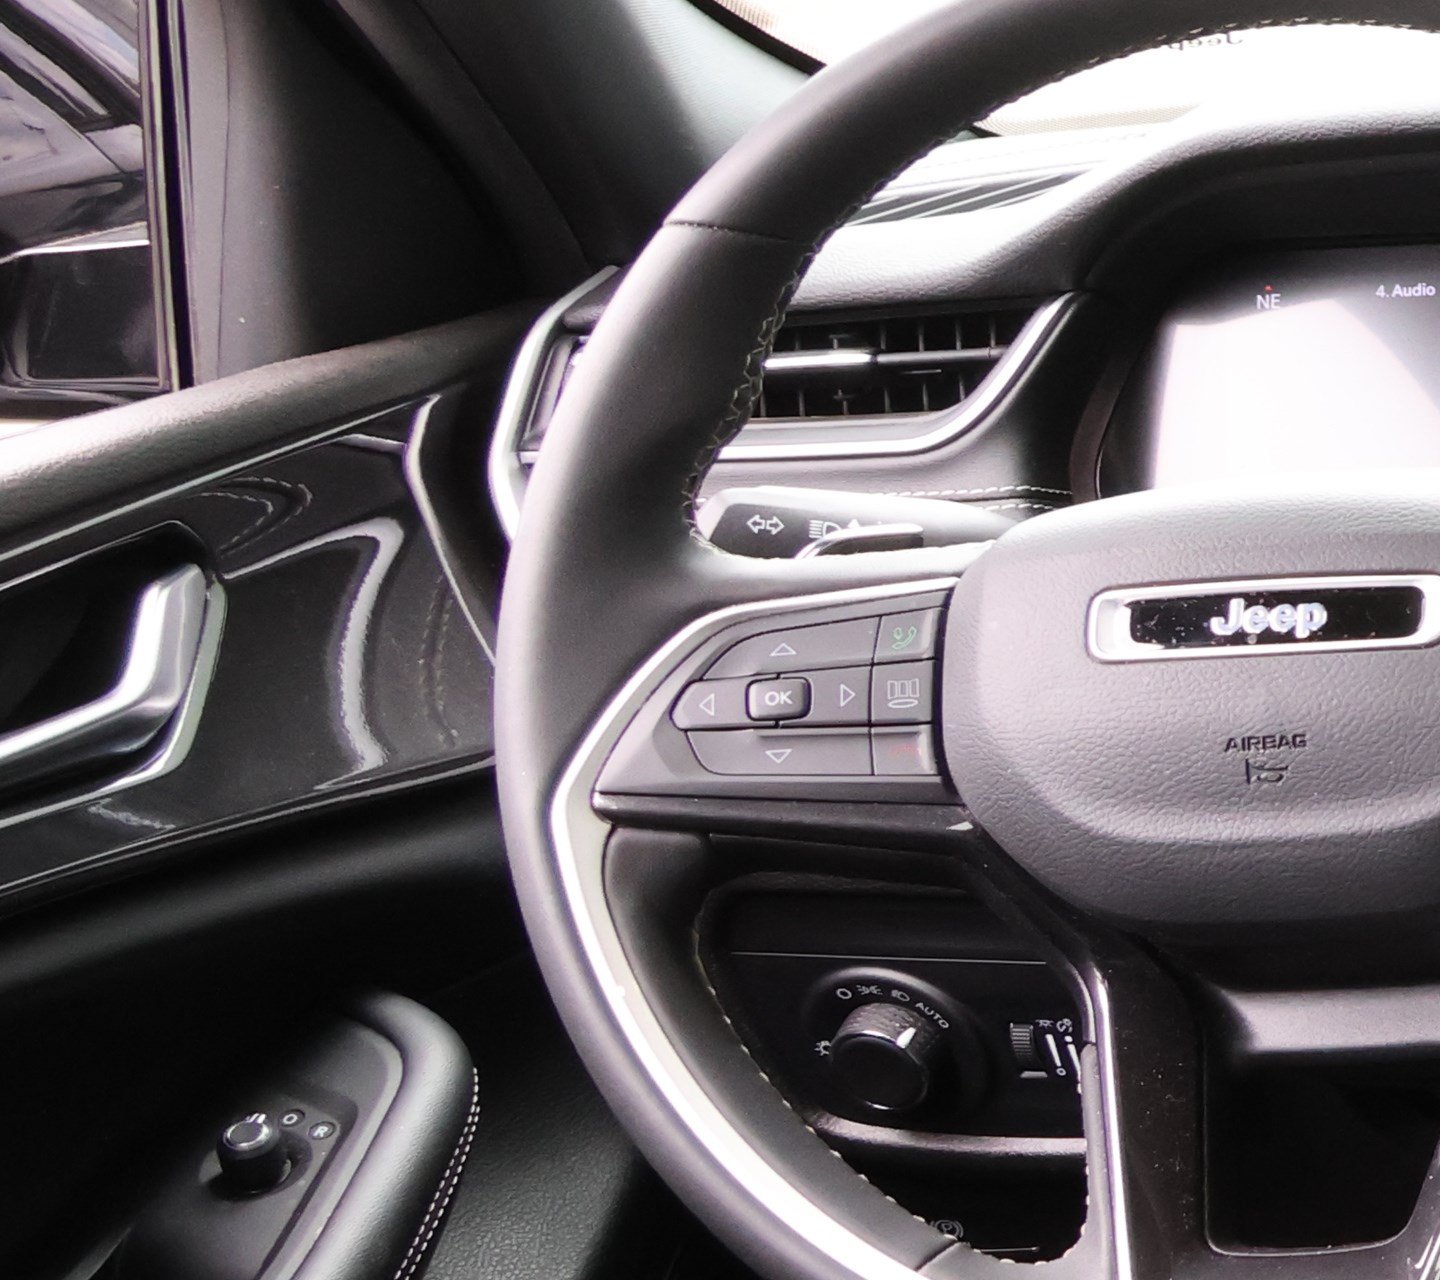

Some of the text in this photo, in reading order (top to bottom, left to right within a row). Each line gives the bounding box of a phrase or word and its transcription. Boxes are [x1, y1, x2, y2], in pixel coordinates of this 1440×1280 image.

[1375, 282, 1437, 299] 4. Audio
[1256, 293, 1282, 310] NE
[1208, 597, 1329, 640] Jeep
[763, 689, 793, 707] OK
[1223, 732, 1309, 754] AIRBAG
[915, 1001, 950, 1029] AUTO
